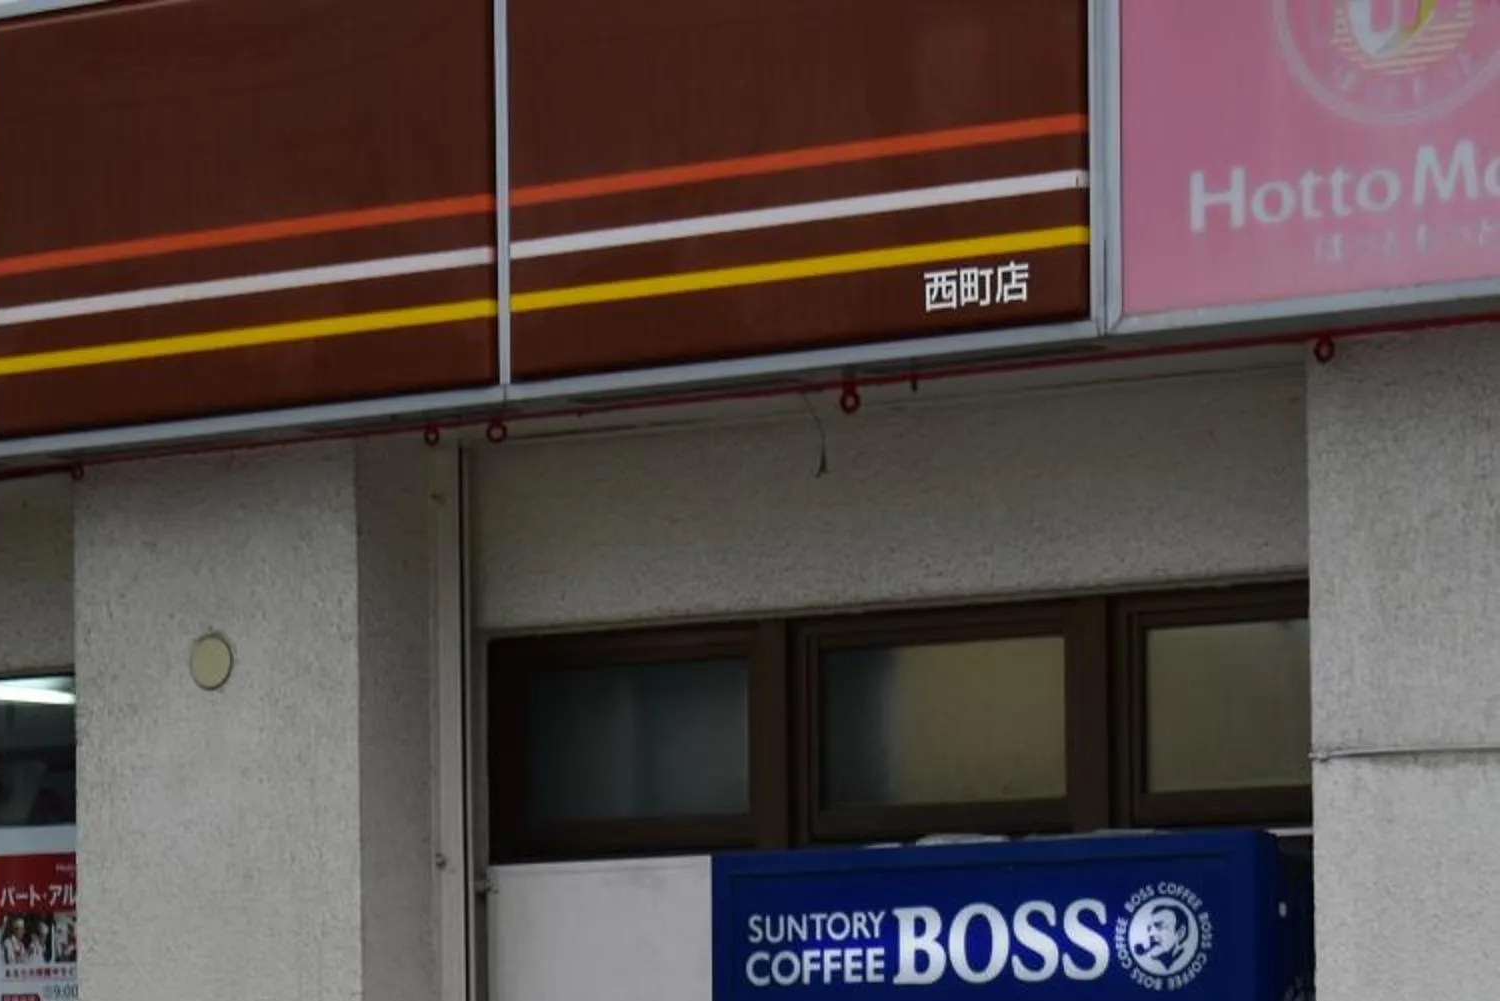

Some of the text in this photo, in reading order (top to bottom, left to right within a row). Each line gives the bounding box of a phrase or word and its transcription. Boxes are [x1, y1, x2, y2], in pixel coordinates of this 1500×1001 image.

[922, 261, 1029, 312] 西町店
[747, 911, 887, 943] SUNTORY
[893, 899, 1111, 985] BOSS
[745, 948, 886, 987] COFFEE
